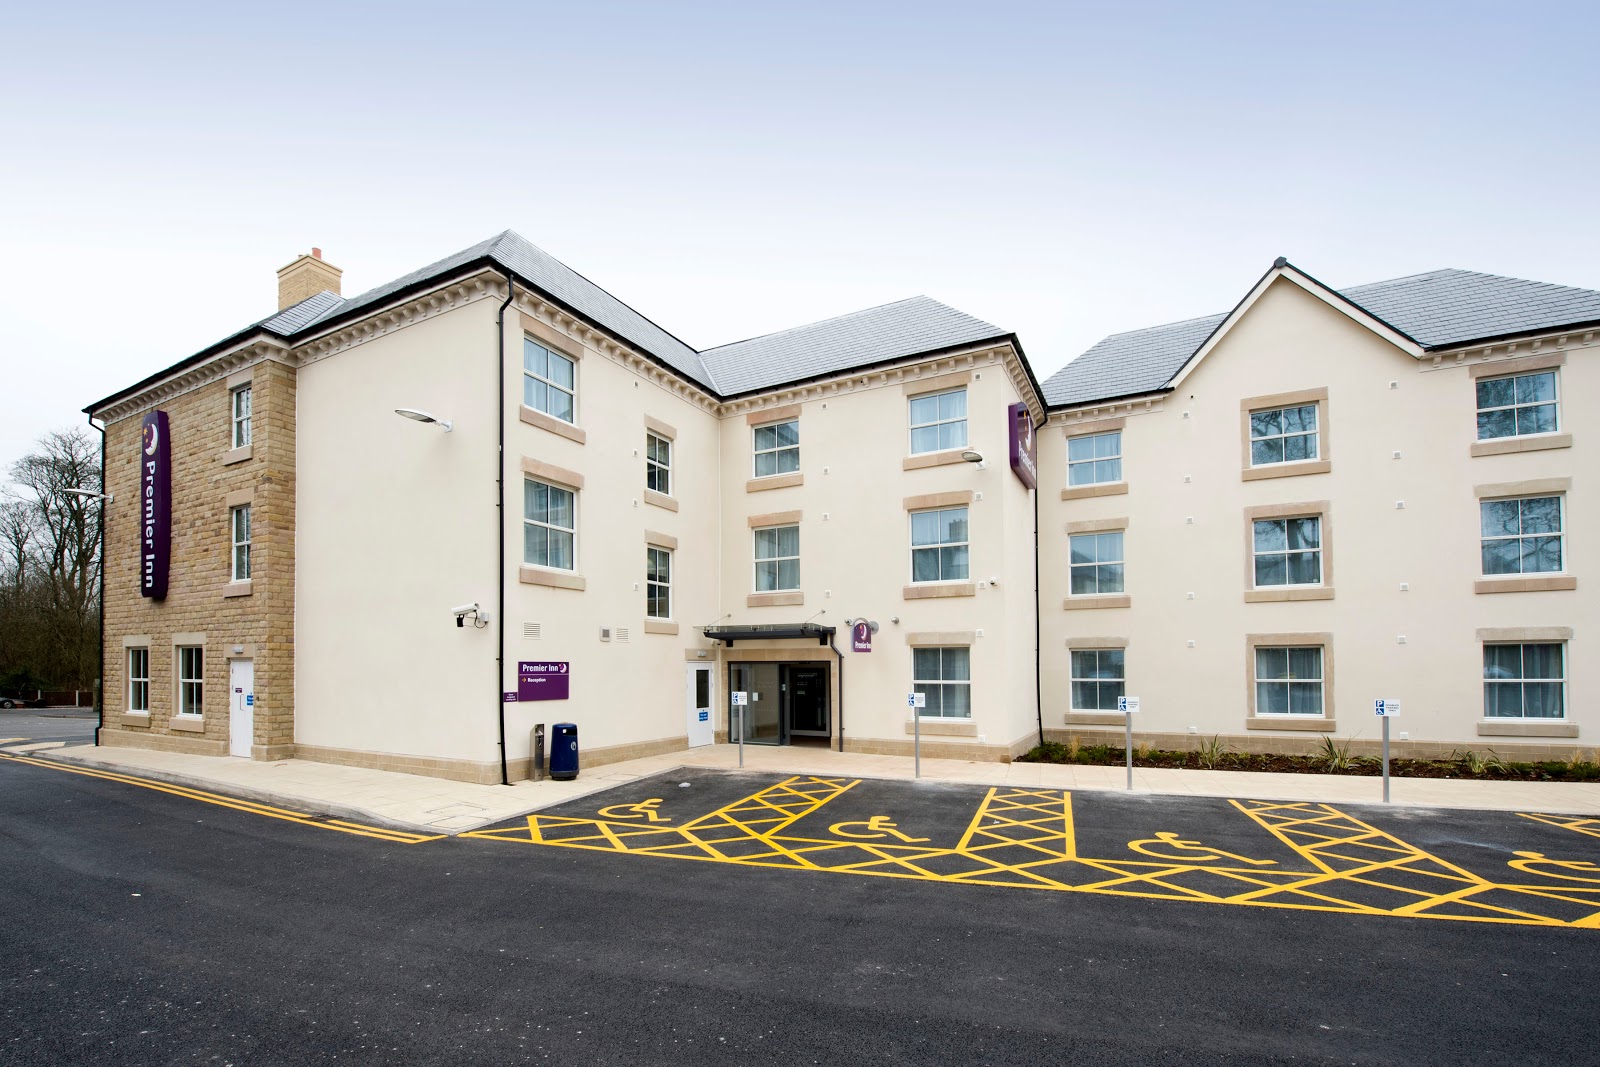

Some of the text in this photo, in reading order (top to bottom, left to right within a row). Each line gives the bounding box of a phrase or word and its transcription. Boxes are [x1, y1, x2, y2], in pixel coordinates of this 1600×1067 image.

[145, 460, 156, 588] Premier Inn
[522, 664, 559, 672] Premier Inn
